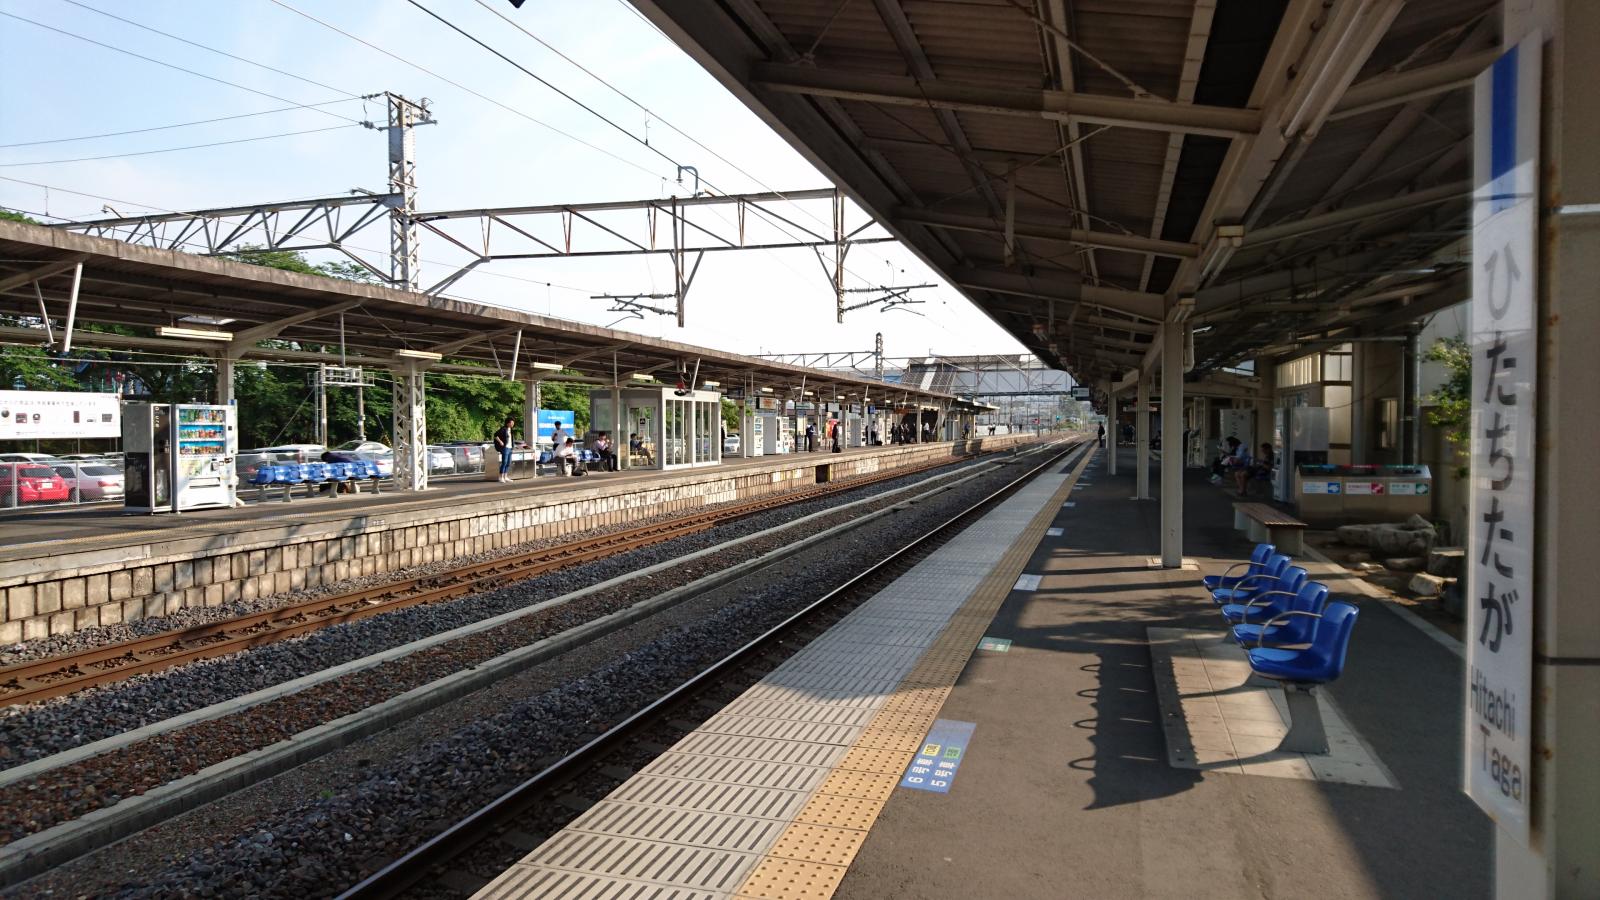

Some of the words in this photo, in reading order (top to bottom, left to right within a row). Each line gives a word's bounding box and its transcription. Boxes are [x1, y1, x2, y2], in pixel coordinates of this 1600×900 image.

[1479, 241, 1521, 654] ひたちたが
[1470, 664, 1515, 742] Hitachi
[1479, 723, 1522, 801] Taga
